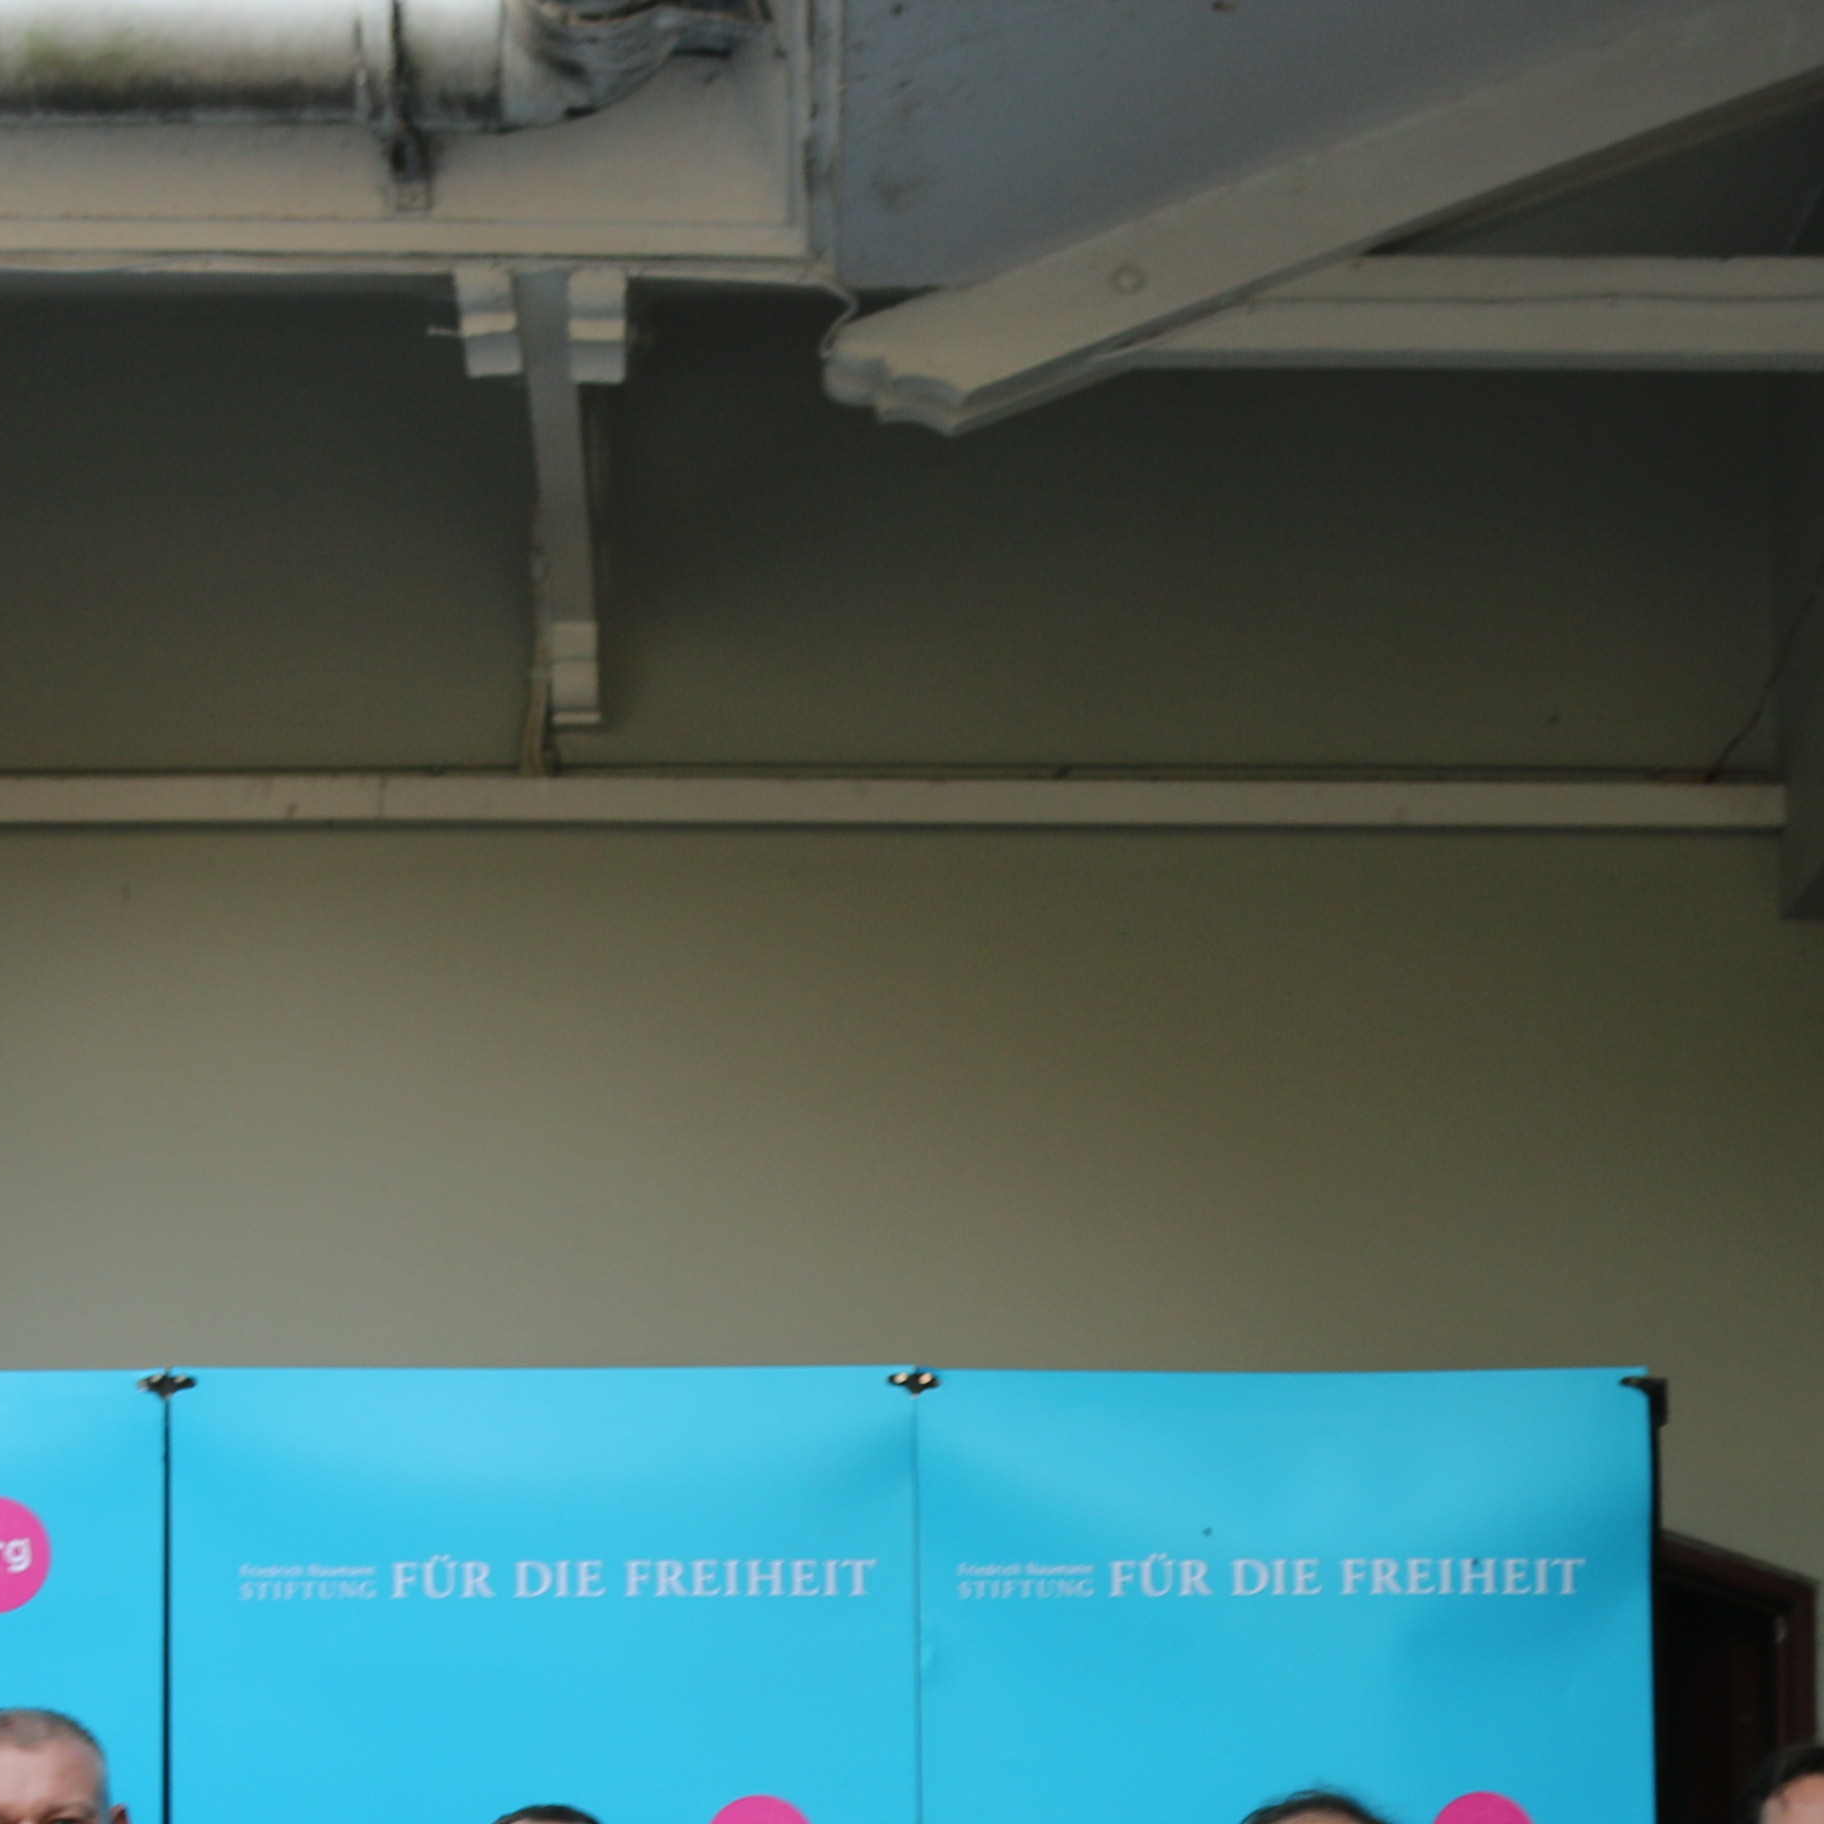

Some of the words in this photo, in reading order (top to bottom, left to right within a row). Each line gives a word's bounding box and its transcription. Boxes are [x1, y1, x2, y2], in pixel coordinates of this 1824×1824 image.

[239, 1580, 377, 1600] STIFTUNG
[390, 1554, 496, 1600] FÜR
[513, 1559, 606, 1599] DIE
[624, 1558, 878, 1599] FREIHEIT
[958, 1578, 1095, 1599] STIFTUNG
[1107, 1552, 1212, 1599] FÜR
[1230, 1557, 1323, 1597] DIE
[1340, 1556, 1586, 1597] FREIHEIT
